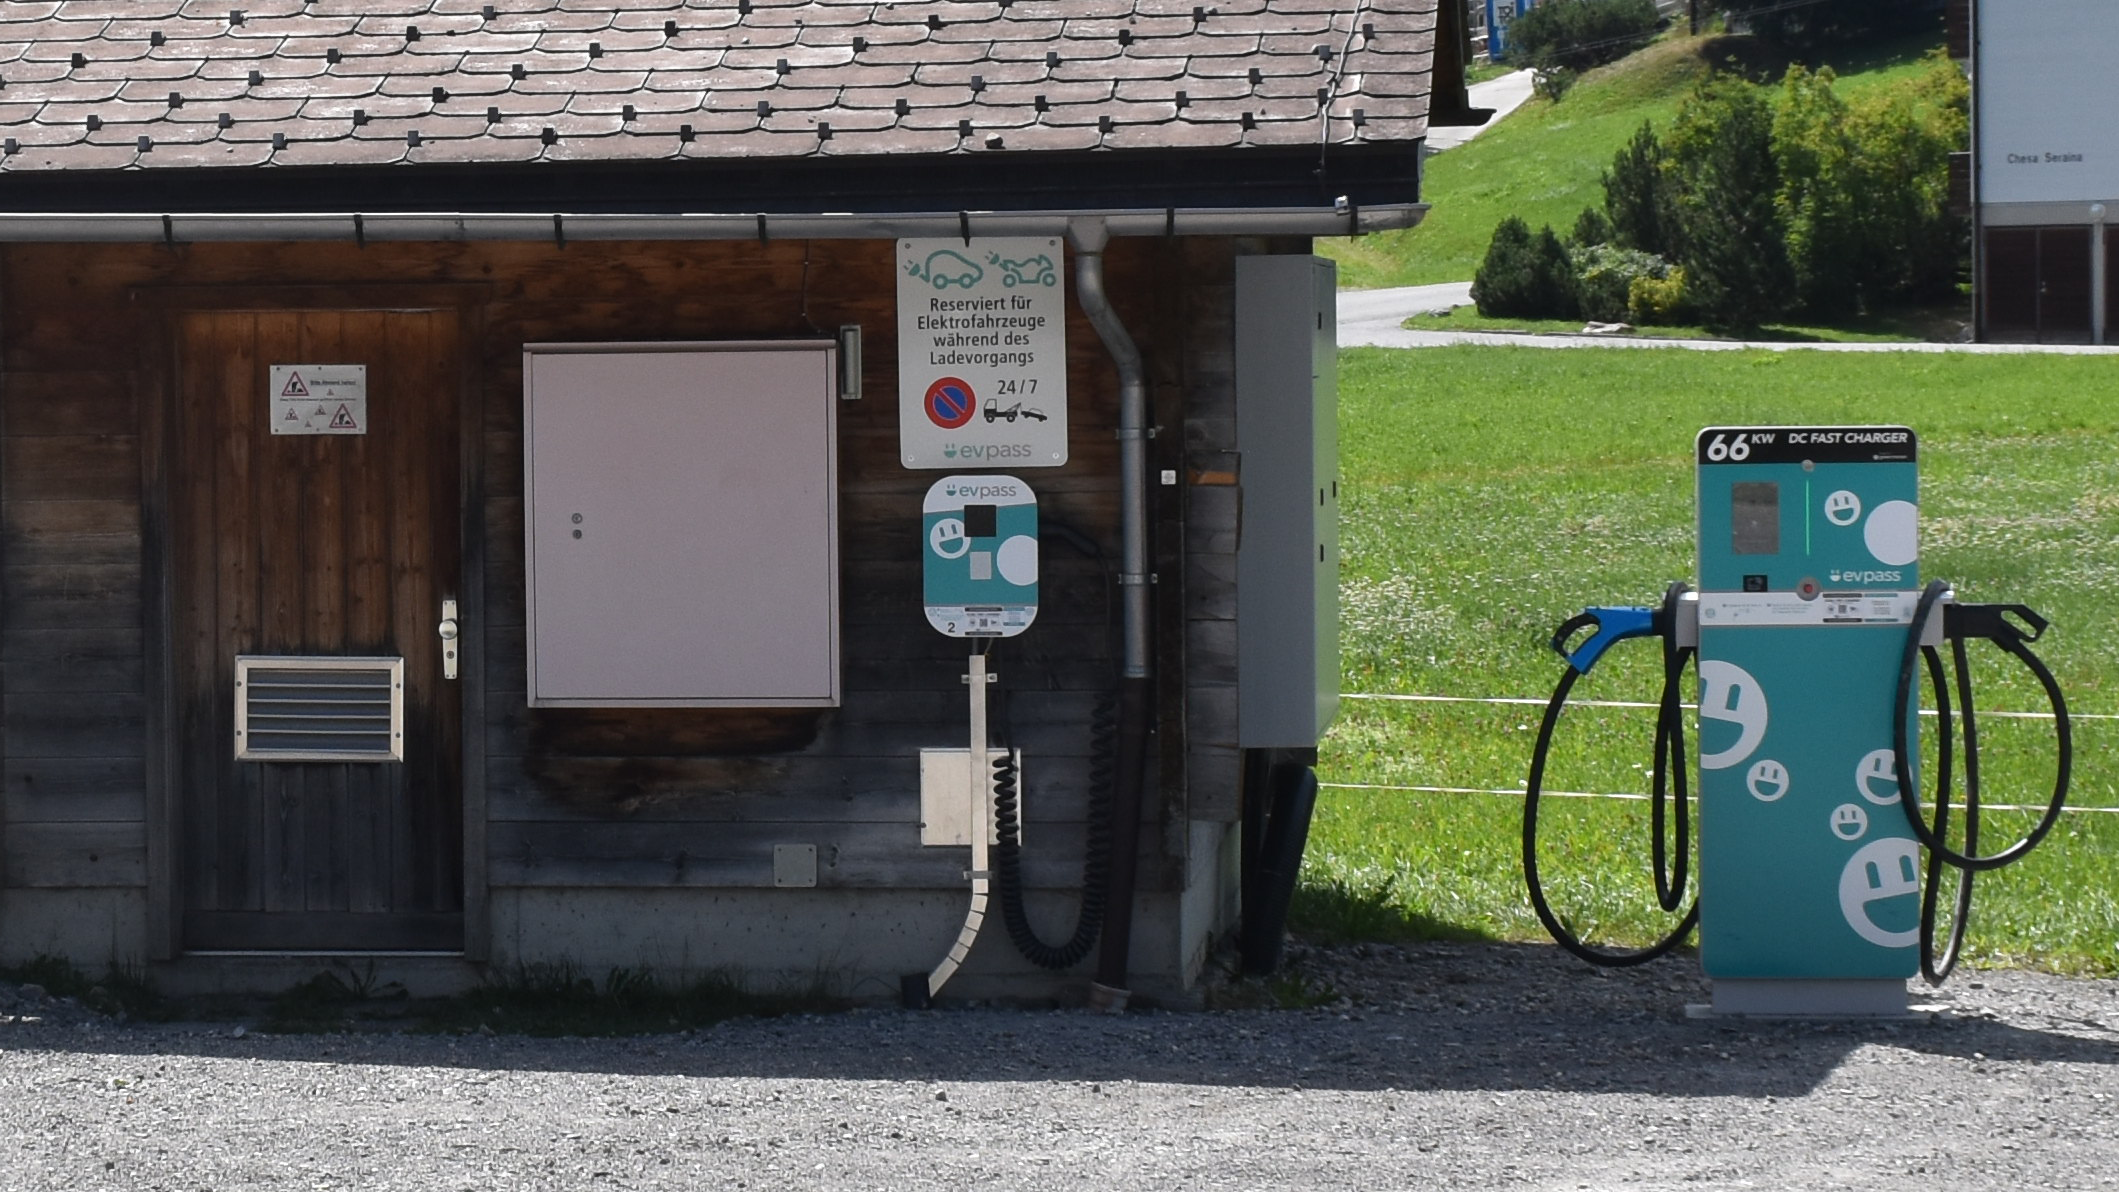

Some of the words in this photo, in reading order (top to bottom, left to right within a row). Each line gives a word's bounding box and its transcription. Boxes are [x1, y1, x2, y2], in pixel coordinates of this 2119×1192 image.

[2007, 153, 2038, 164] Chesa
[2045, 152, 2083, 163] Seraina
[931, 296, 1005, 311] Reserviert
[1011, 295, 1032, 309] für
[918, 314, 1045, 332] Elektrofahrzeuge
[933, 331, 998, 346] während
[1005, 331, 1029, 345] des
[931, 350, 1033, 367] Ladevorgangs
[1789, 433, 1808, 443] DC
[1811, 433, 1843, 443] FAST
[1845, 432, 1908, 443] CHARGER
[960, 444, 1031, 461] evpass
[1707, 433, 1750, 461] 66
[1752, 434, 1775, 444] KW
[959, 485, 1017, 499] evpass
[1843, 570, 1902, 584] evpass
[948, 622, 955, 633] 2
